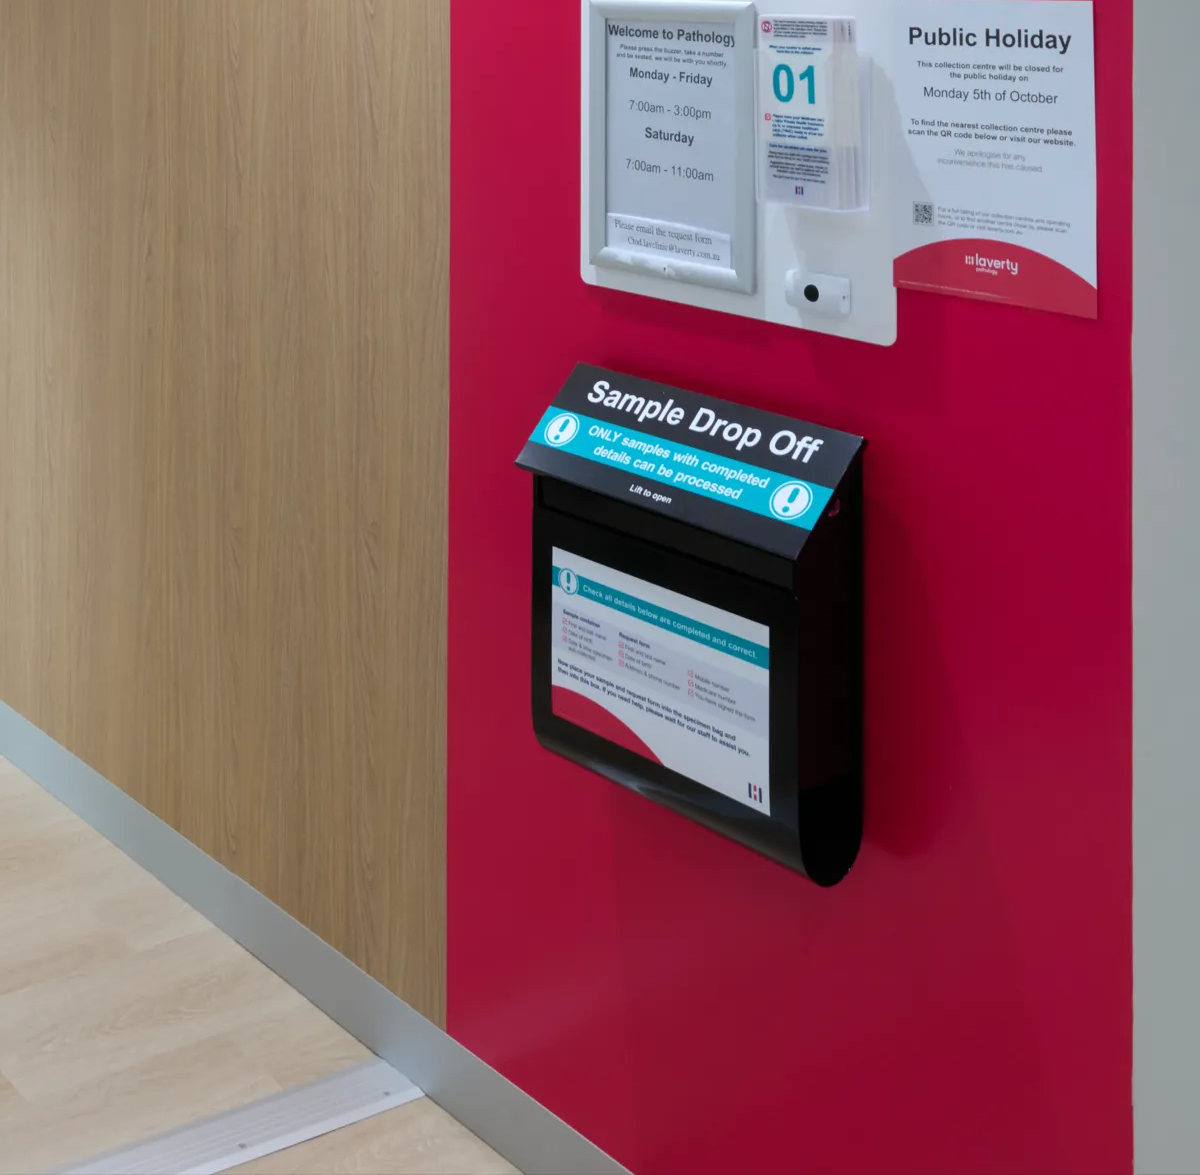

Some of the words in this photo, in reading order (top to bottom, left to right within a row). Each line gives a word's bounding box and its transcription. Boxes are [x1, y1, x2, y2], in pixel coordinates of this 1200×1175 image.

[608, 24, 659, 39] Welcome
[662, 28, 674, 40] to
[677, 29, 735, 47] Pathology
[908, 27, 977, 47] Public
[986, 29, 1071, 54] Holiday
[620, 43, 637, 52] Please
[630, 67, 670, 83] Monday
[679, 72, 712, 87] Friday
[934, 61, 970, 70] collection
[972, 63, 996, 71] centre
[998, 63, 1012, 71] will
[1024, 65, 1050, 73] closed
[1052, 65, 1064, 73] for
[950, 71, 962, 79] the
[964, 72, 986, 81] public
[989, 73, 1016, 83] holiday
[772, 63, 816, 105] 01
[924, 87, 970, 101] Monday
[972, 89, 991, 101] 5th
[995, 90, 1006, 101] of
[1010, 91, 1058, 105] October
[630, 100, 664, 114] 7:00am
[674, 105, 711, 120] 3:00pm
[645, 127, 694, 147] Saturday
[921, 119, 936, 127] find
[937, 120, 949, 128] the
[980, 123, 1018, 132] collection
[1047, 127, 1072, 136] please
[927, 129, 938, 137] the
[954, 131, 972, 139] code
[974, 133, 998, 141] below
[1010, 135, 1026, 143] visit
[1044, 137, 1076, 147] website.
[626, 159, 660, 173] 7:00am
[672, 165, 714, 181] 11:00am
[614, 219, 634, 231] Please
[636, 224, 654, 235] email
[656, 227, 666, 237] the
[668, 231, 692, 243] request
[694, 234, 712, 245] form
[976, 253, 1018, 275] laverty
[587, 380, 685, 426] Sample
[689, 407, 762, 451] Drop
[768, 430, 824, 463] Off
[588, 425, 622, 443] ONLY
[622, 436, 670, 459] samples
[672, 451, 698, 467] with
[701, 461, 770, 489] completed
[593, 445, 631, 465] details
[632, 459, 655, 473] can
[657, 463, 673, 478] be
[674, 471, 743, 501] processed
[629, 483, 643, 495] Lift
[644, 489, 652, 498] to
[652, 491, 672, 505] open
[583, 585, 603, 599] Check
[604, 593, 612, 602] all
[614, 597, 636, 613] details
[638, 606, 658, 621] below
[660, 615, 670, 625] are
[672, 621, 710, 641] completed
[712, 633, 726, 647] and
[728, 643, 758, 659] correct.
[558, 657, 569, 669] Now
[570, 662, 582, 674] place
[584, 669, 595, 679] your
[596, 673, 614, 686] sample
[616, 680, 626, 691] and
[626, 685, 646, 700] request
[647, 693, 661, 706] form
[662, 700, 672, 711] into
[674, 705, 682, 716] the
[684, 711, 711, 731] specimen
[712, 723, 724, 737] bag
[725, 730, 736, 741] and
[558, 666, 568, 677] then
[570, 671, 579, 682] into
[580, 675, 590, 686] this
[607, 689, 618, 700] you
[618, 693, 631, 705] need
[646, 704, 663, 719] please
[664, 713, 676, 725] wait
[677, 719, 685, 728] for
[686, 723, 697, 733] our
[698, 727, 711, 741] staff
[712, 733, 718, 743] to
[719, 737, 736, 750] assist
[738, 747, 751, 758] you.
